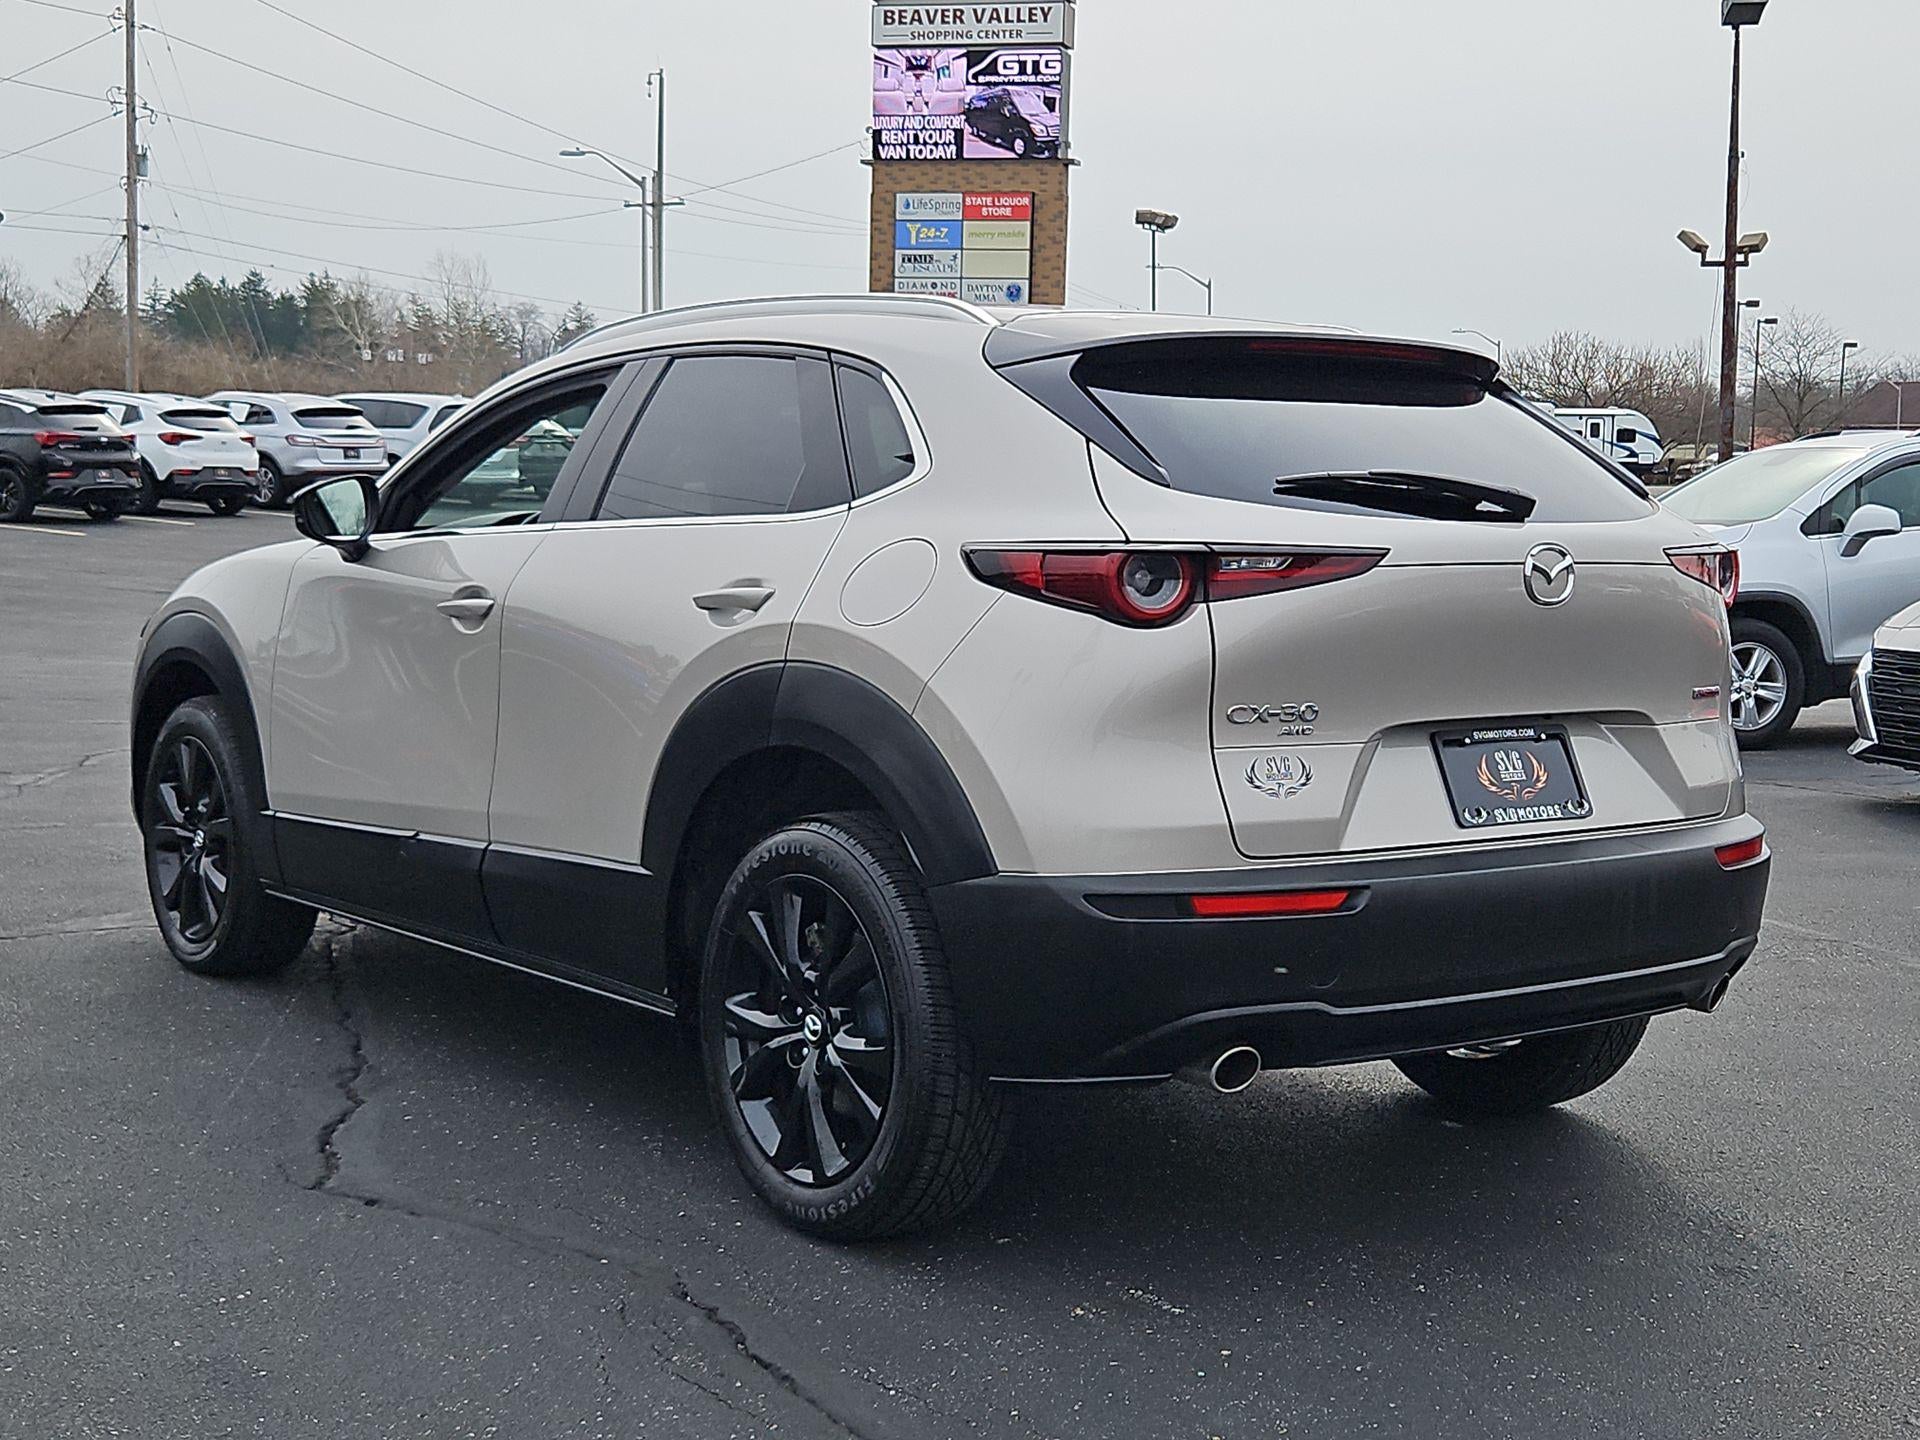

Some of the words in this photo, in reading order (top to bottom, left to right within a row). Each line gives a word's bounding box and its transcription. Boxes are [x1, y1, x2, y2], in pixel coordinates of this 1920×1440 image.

[883, 8, 965, 26] BEAVER
[972, 6, 1053, 24] VALLEY
[909, 29, 973, 41] SHOPPING
[977, 29, 1023, 39] CENTER
[997, 54, 1062, 75] GTG
[904, 116, 924, 129] AND
[924, 114, 966, 130] COMFORT
[881, 129, 917, 144] RENT
[917, 129, 955, 144] YOUR
[878, 144, 907, 159] VAN
[907, 144, 957, 159] TODAY!
[912, 198, 961, 213] LifeSpring
[965, 197, 993, 206] STATE
[994, 196, 1030, 206] LIQUOR
[981, 207, 1012, 217] STORE
[919, 227, 949, 239] 24-7
[968, 230, 997, 240] merry
[901, 253, 935, 264] TIME
[912, 263, 958, 273] ESCAPE
[898, 281, 957, 290] DIAMOND
[967, 284, 1004, 292] DAYTON
[974, 293, 997, 302] MMA
[1226, 702, 1319, 724] CX-30
[1277, 725, 1315, 736] AWD
[1472, 728, 1535, 740] SVGMOTORS.COM
[1265, 755, 1292, 775] SVG
[1494, 750, 1524, 772] SVG
